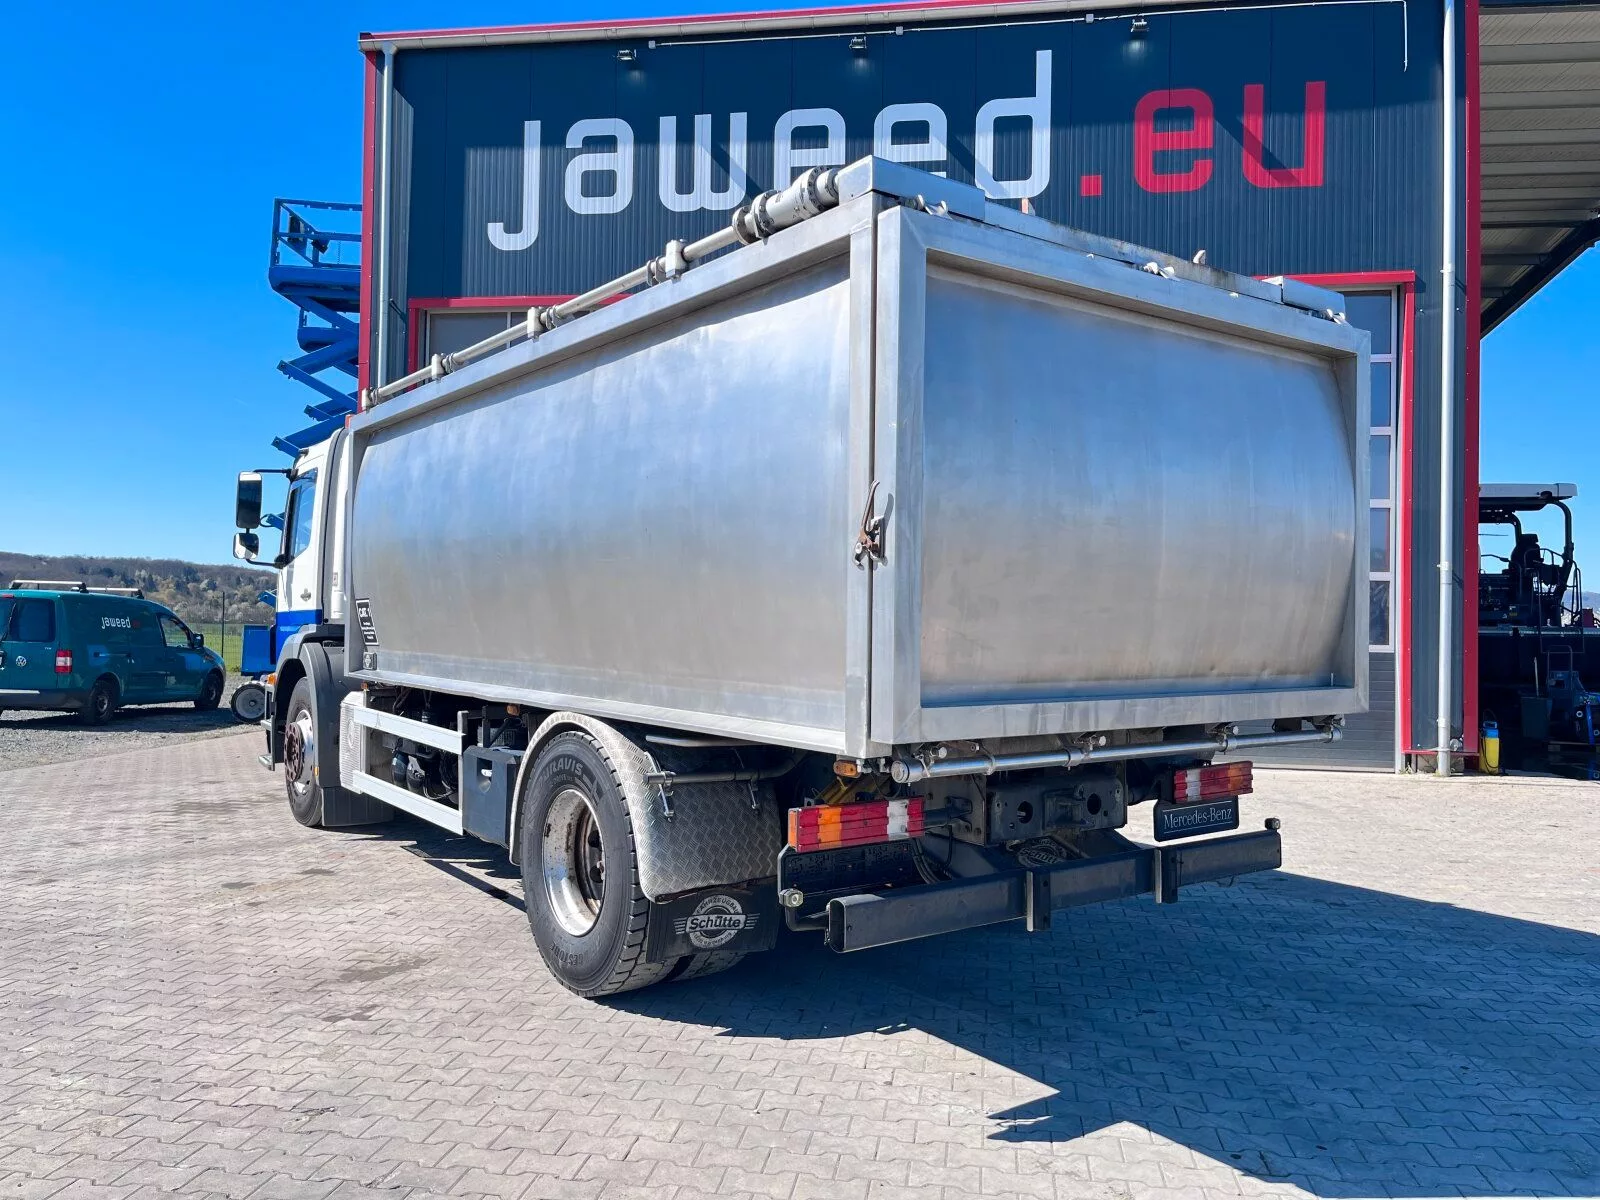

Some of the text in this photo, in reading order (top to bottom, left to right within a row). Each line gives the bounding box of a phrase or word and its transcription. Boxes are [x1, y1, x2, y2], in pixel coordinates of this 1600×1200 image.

[487, 50, 1326, 251] jaweed.eu
[1163, 807, 1233, 830] Mercedes-Benz
[689, 914, 742, 931] Schütte
